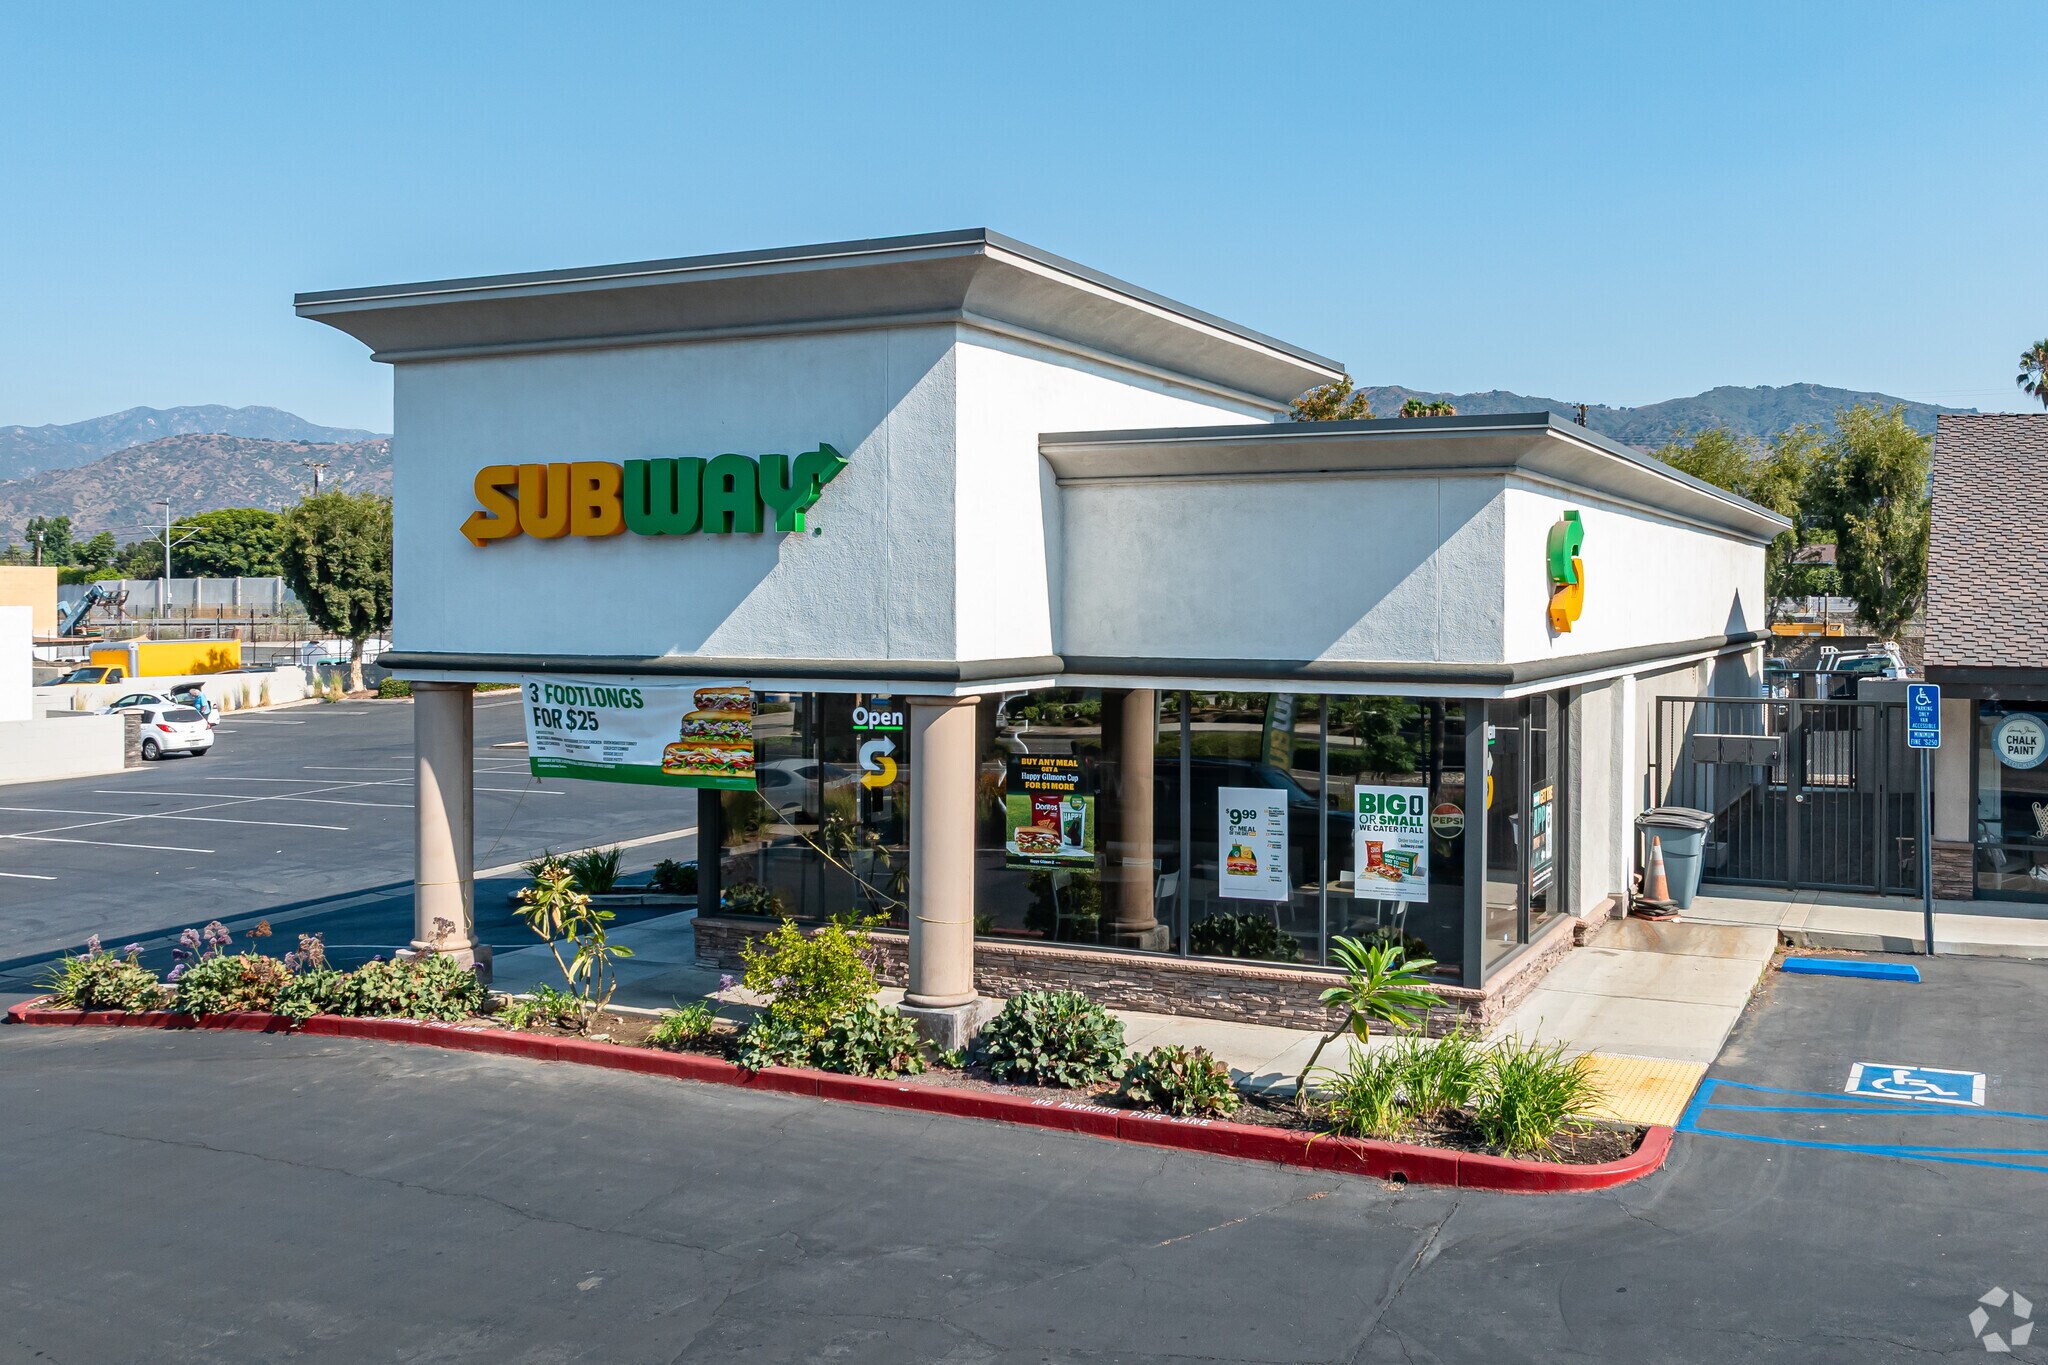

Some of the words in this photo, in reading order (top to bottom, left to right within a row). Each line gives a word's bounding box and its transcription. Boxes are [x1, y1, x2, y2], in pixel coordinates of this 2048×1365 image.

[459, 442, 848, 547] SUBWAY
[528, 682, 539, 703] 3
[544, 684, 644, 709] FOOTLONGS
[533, 706, 562, 730] FOR
[566, 707, 599, 732] $25
[852, 706, 904, 730] Open
[2006, 736, 2036, 745] CHALK
[2008, 746, 2035, 755] PAINT
[2004, 758, 2038, 768] STOCKIST
[1022, 772, 1041, 781] Happy
[1042, 773, 1066, 781] Gilmore
[1067, 774, 1078, 782] Cup
[1042, 782, 1050, 790] $1
[1359, 793, 1406, 815] BIG
[1063, 812, 1082, 821] HAPPY
[1359, 814, 1376, 824] OR
[1379, 815, 1423, 826] SMALL
[1432, 816, 1463, 825] PEPSI
[1058, 1102, 1120, 1115] PARKING
[1129, 1110, 1167, 1121] FIRE
[1170, 1116, 1212, 1126] LANE
